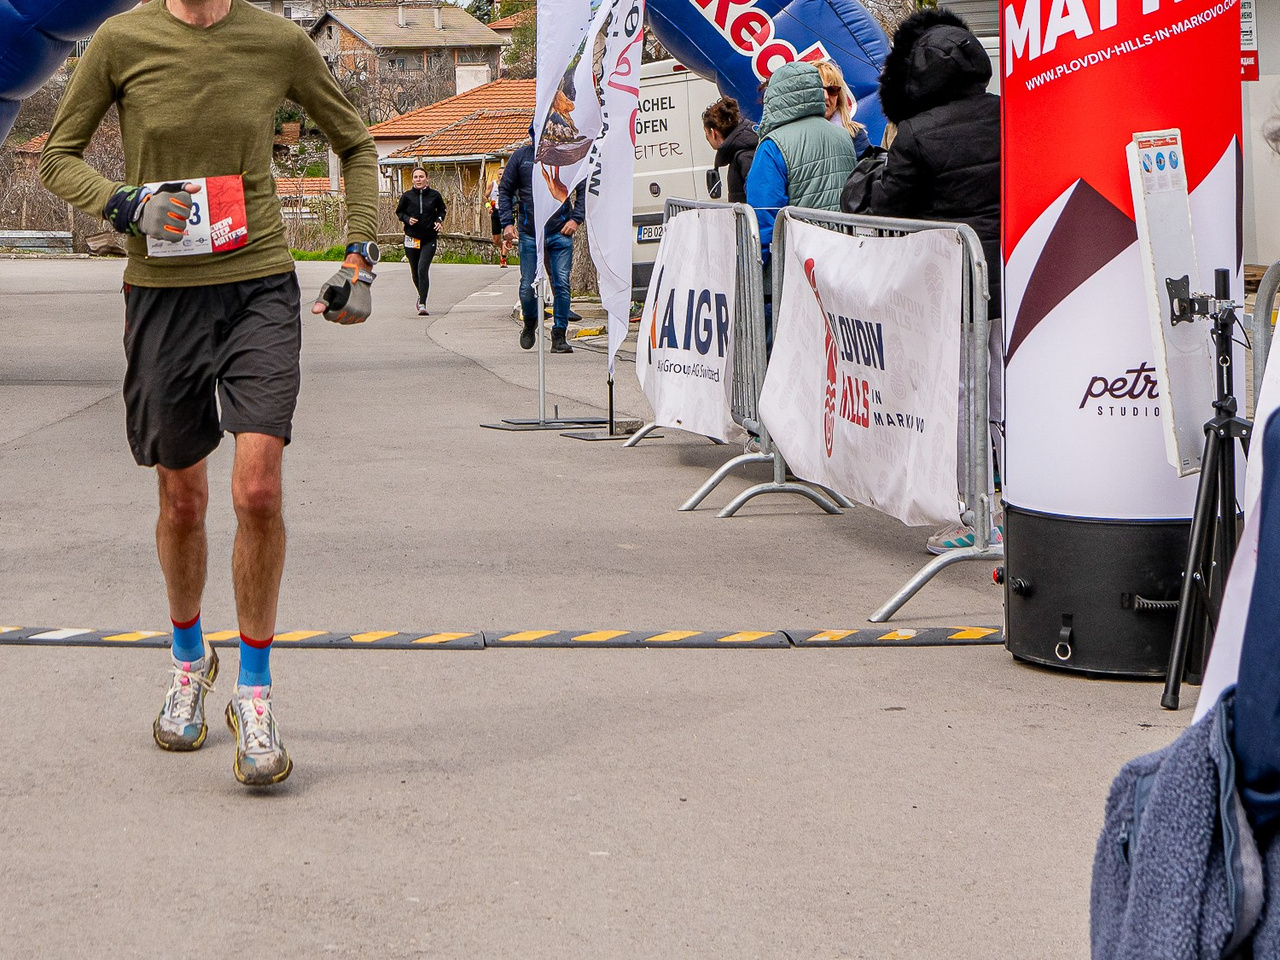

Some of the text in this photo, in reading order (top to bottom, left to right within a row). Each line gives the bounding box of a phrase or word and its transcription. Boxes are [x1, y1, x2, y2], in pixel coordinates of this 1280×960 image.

[637, 96, 675, 113] ACHEL
[636, 118, 668, 135] ÖFEN
[635, 142, 683, 161] EITER
[1079, 361, 1160, 409] petr
[871, 389, 882, 405] IN
